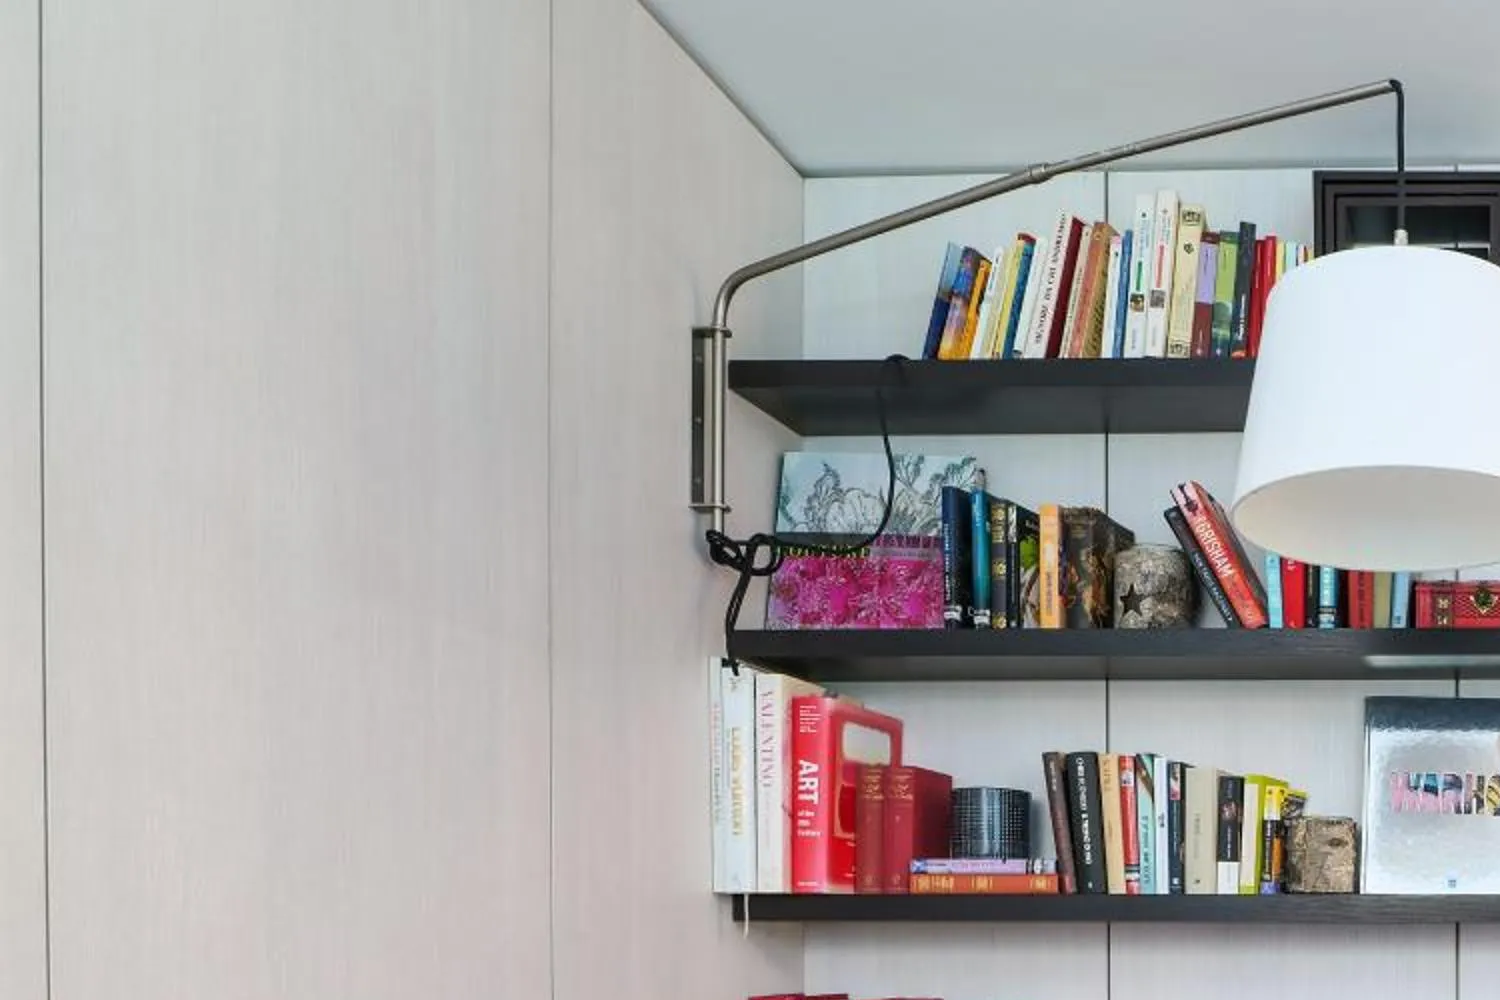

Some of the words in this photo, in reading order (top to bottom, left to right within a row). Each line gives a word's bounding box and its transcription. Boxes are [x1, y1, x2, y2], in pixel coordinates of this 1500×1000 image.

[1196, 521, 1236, 578] GRISHAM
[760, 690, 774, 788] VALENTINO
[798, 759, 819, 804] ART
